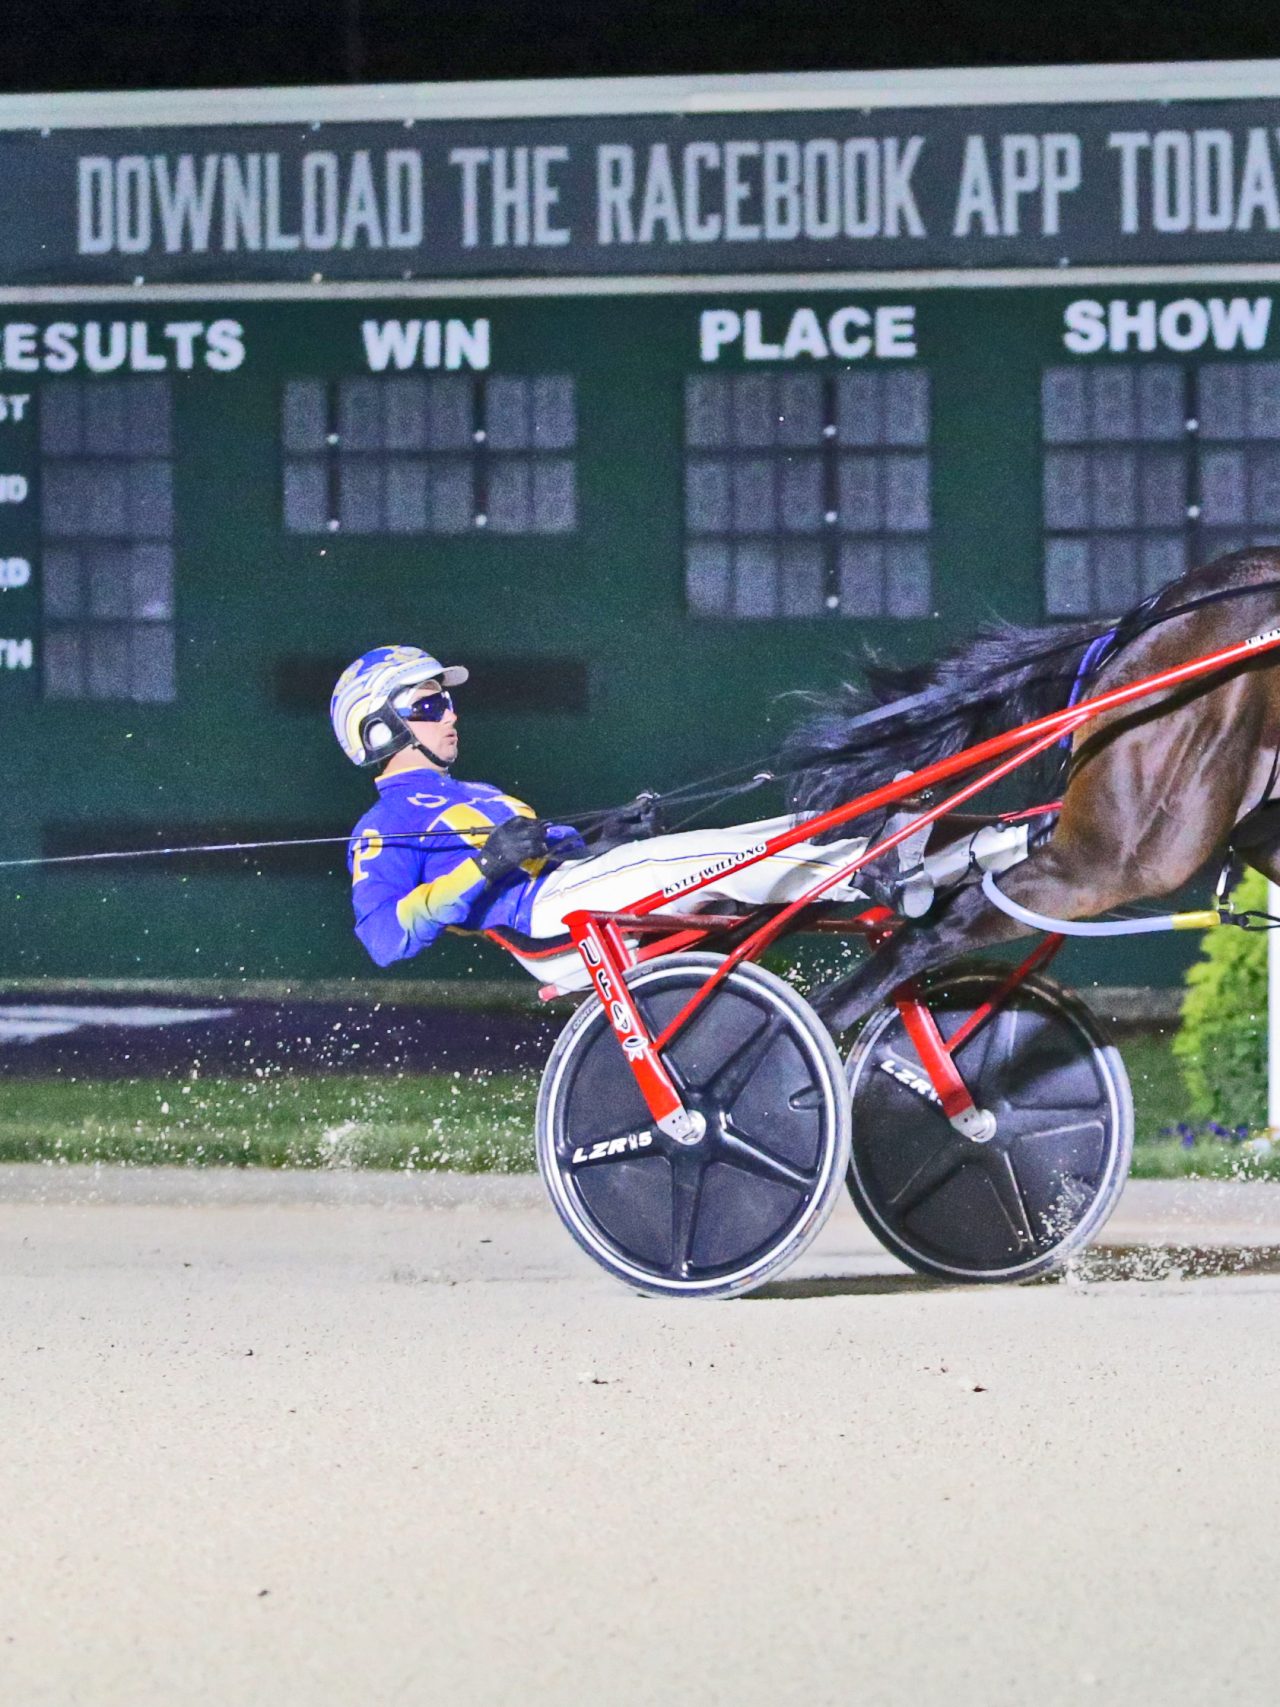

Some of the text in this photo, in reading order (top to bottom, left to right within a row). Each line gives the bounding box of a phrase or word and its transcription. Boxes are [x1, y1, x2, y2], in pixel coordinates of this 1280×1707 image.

[78, 150, 424, 254] DOWNLOAD
[449, 145, 571, 248] THE
[597, 135, 926, 245] RACEBOOK
[953, 132, 1082, 237] APP
[0, 319, 246, 373] ESULTS
[363, 318, 490, 371] WIN
[700, 306, 917, 362] PLACE
[1063, 297, 1272, 354] SHOW
[664, 873, 700, 896] KYLE
